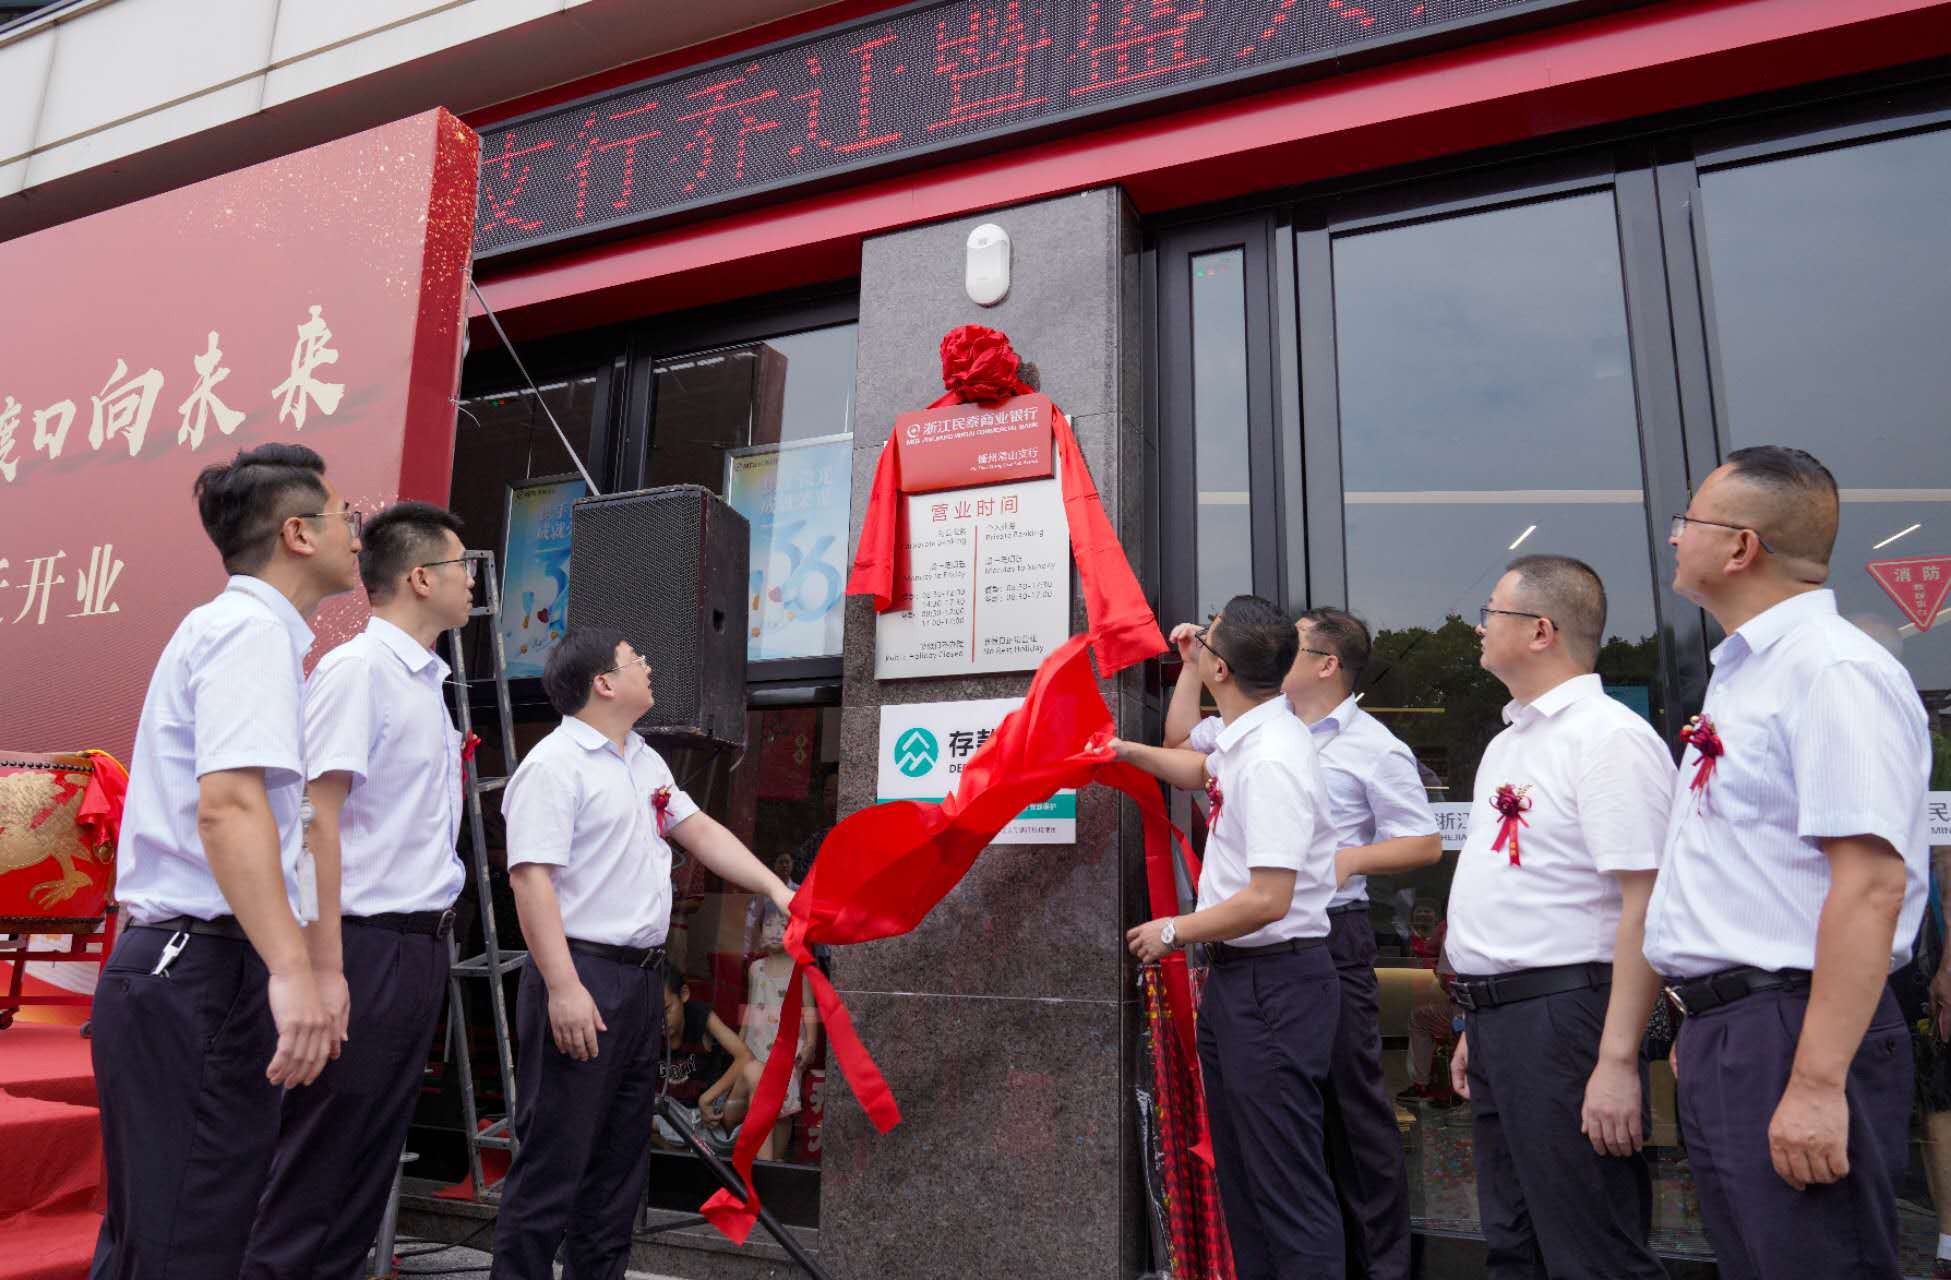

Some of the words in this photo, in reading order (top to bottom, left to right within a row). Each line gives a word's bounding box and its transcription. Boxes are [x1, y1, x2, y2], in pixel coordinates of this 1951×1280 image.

[923, 406, 1039, 436] 浙江民泰商业银行
[932, 495, 1018, 522] 营业时间
[0, 544, 125, 625] 开业
[1889, 565, 1940, 582] 消防
